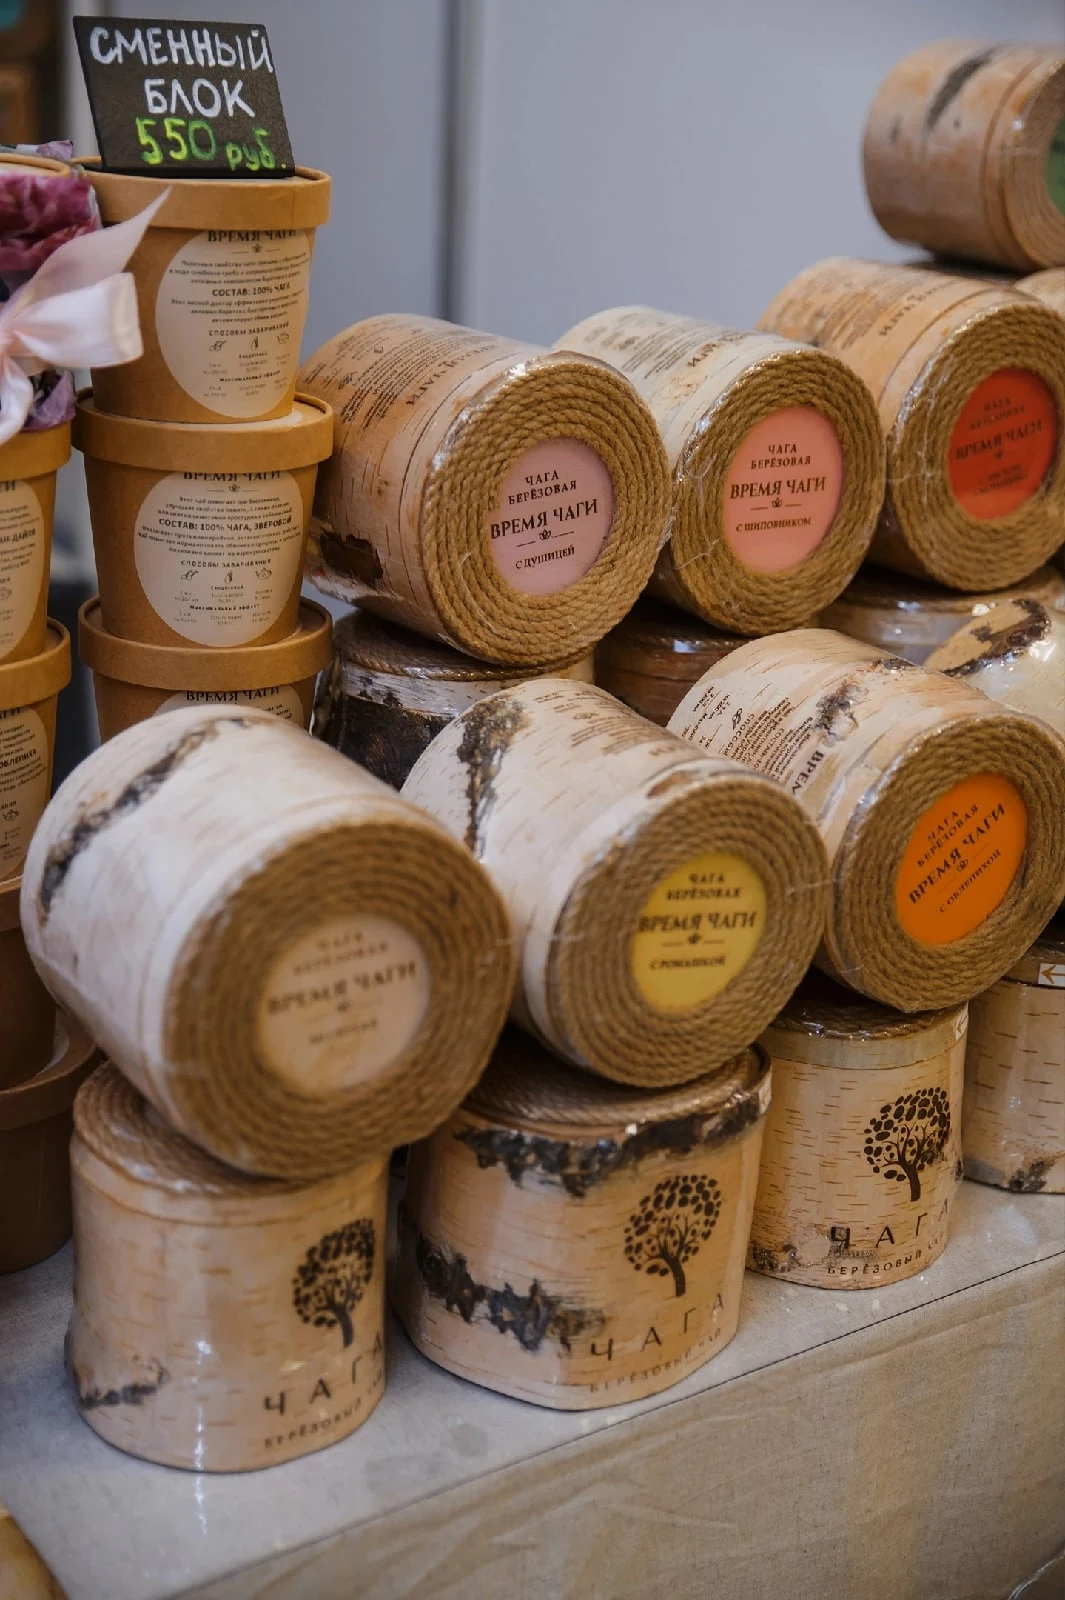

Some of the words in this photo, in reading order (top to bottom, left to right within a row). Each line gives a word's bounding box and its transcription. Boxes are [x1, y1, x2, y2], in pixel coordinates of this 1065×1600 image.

[90, 26, 274, 73] СМЕННЫЙ
[145, 79, 255, 117] БЛОК
[136, 116, 216, 165] 550
[226, 128, 287, 171] руб.
[208, 231, 260, 241] ВРЕМЯ
[212, 288, 249, 297] СОСТАВ:
[768, 443, 797, 454] ЧАГА
[751, 456, 810, 469] БЕРЁЗОВАЯ
[525, 470, 559, 486] ЧАГА
[730, 480, 782, 499] ВРЕМЯ
[786, 477, 826, 493] ЧАГИ
[508, 480, 576, 504] БЕРЁЗОВАЯ
[159, 518, 198, 530] СОСТАВ:
[200, 523, 224, 531] 100%
[227, 523, 252, 532] ЧАГА,
[490, 511, 548, 539] ВРЕМЯ
[553, 499, 598, 522] ЧАГИ
[186, 691, 238, 702] ВРЕМЯ
[243, 687, 279, 699] ЧАГИ
[928, 811, 958, 840] ЧАГА
[909, 848, 961, 904] ВРЕМЯ
[962, 803, 1005, 846] ЧАГИ
[689, 873, 724, 884] ЧАГА
[638, 914, 702, 932] ВРЕМЯ
[708, 912, 756, 929] ЧАГИ
[268, 979, 347, 1015] ВРЕМЯ
[355, 961, 416, 989] ЧАГИ
[831, 1199, 948, 1249] ЧАГА
[828, 1250, 922, 1275] БЕРЁЗОВЫЙ
[591, 1293, 724, 1361] ЧАГА
[264, 1332, 384, 1416] ЧАГА
